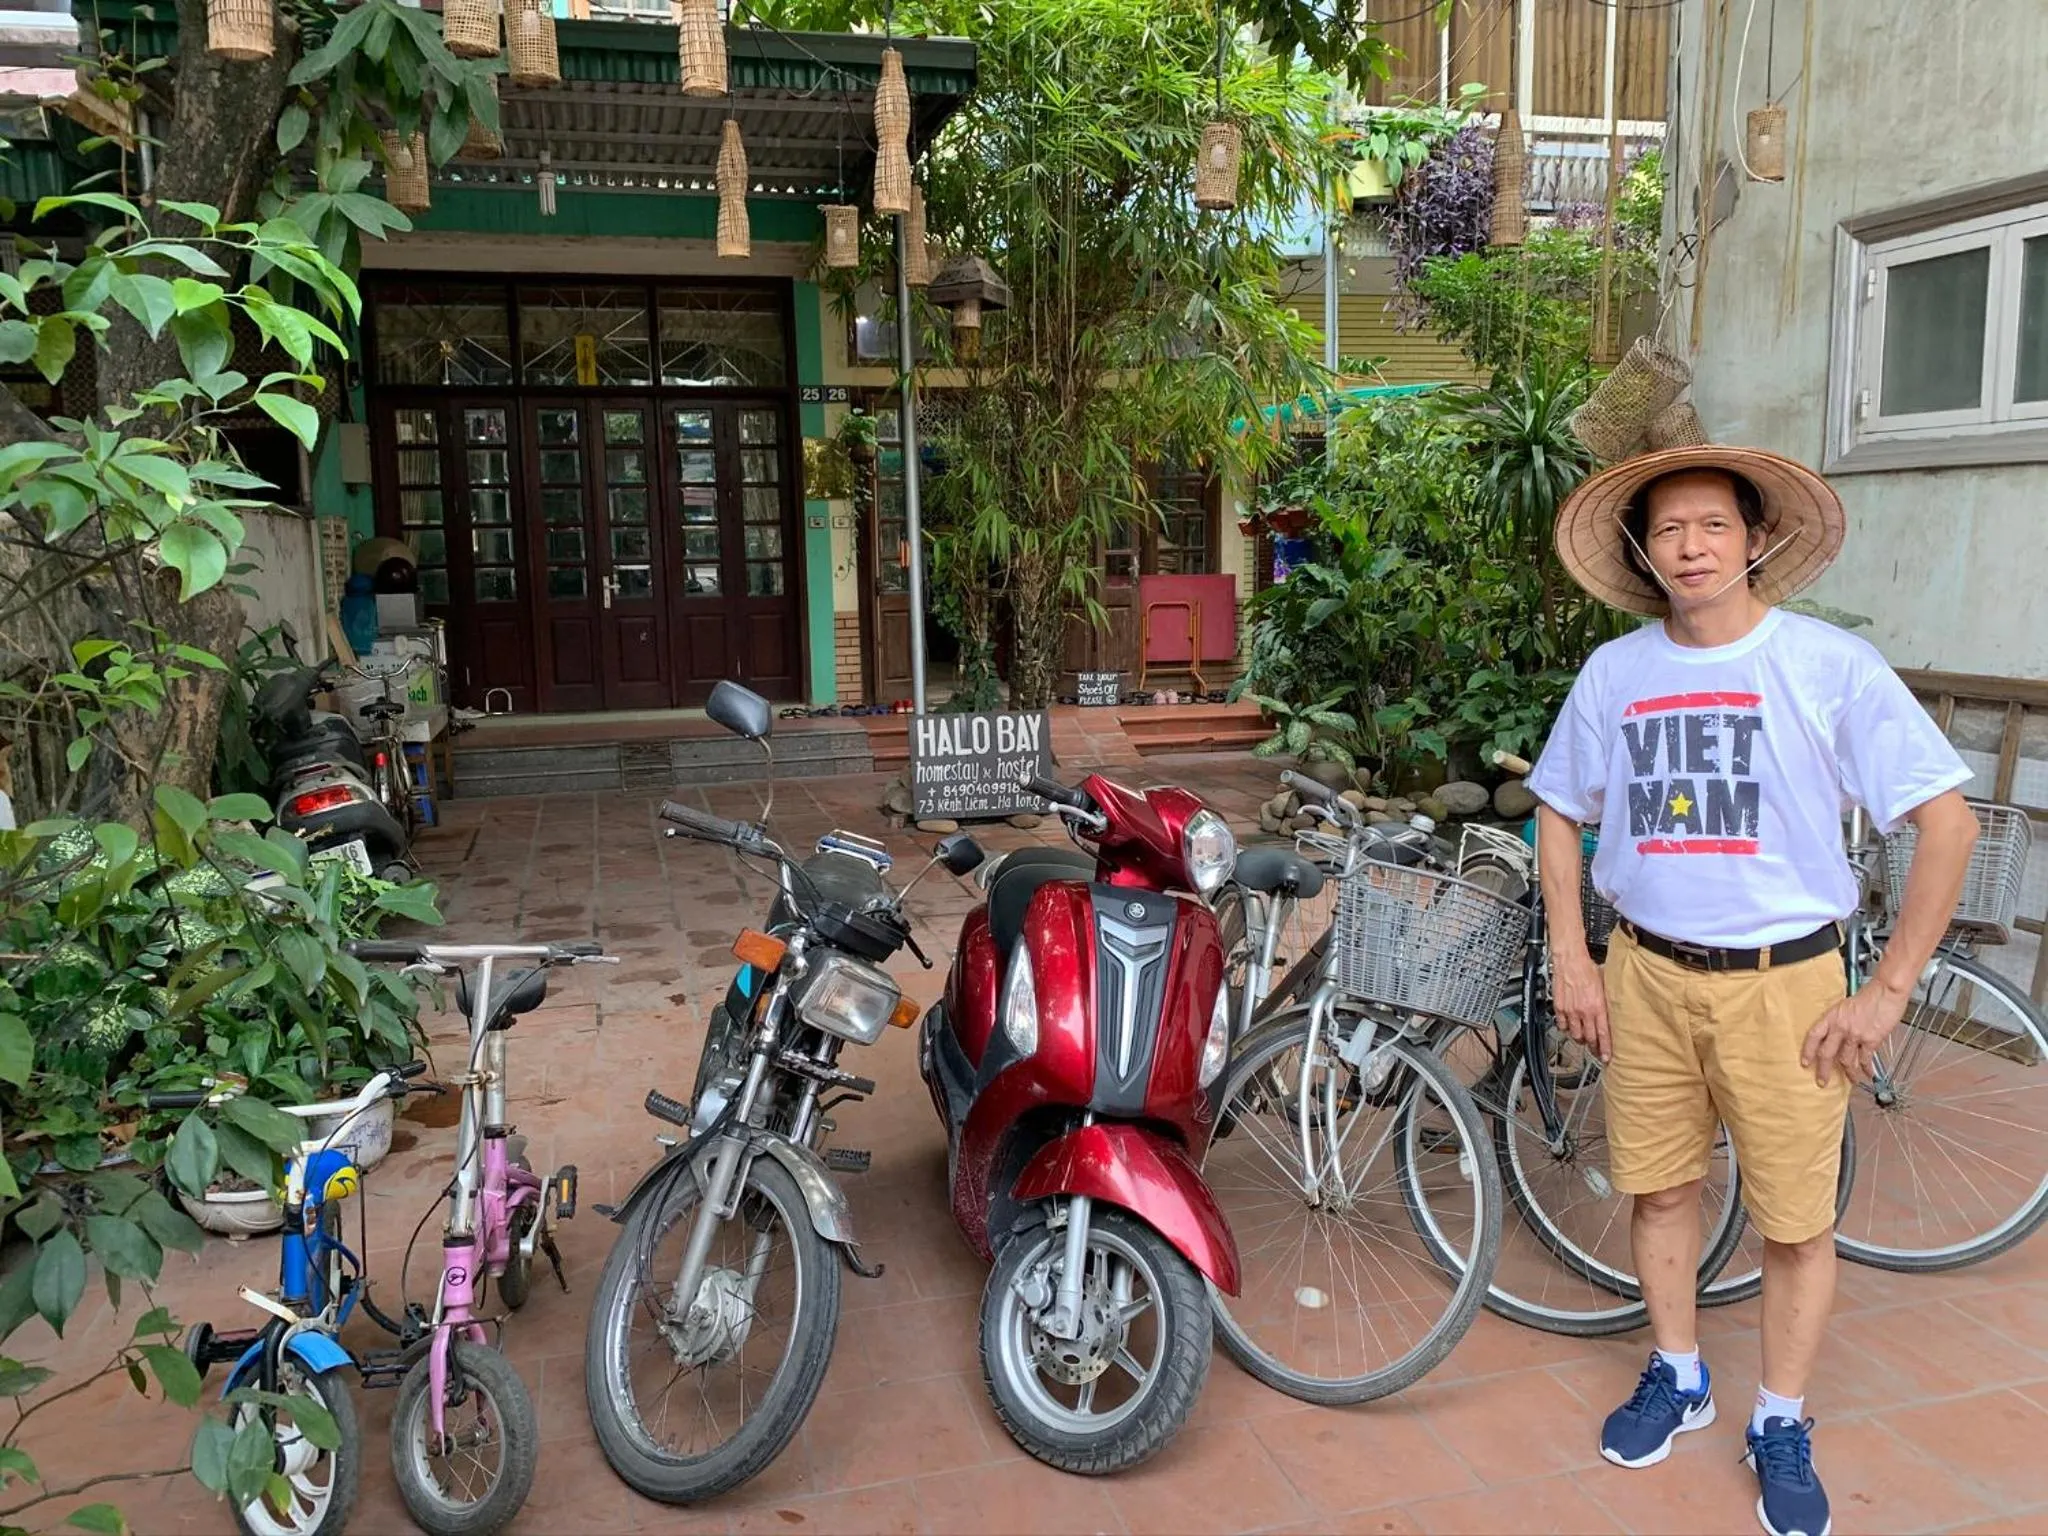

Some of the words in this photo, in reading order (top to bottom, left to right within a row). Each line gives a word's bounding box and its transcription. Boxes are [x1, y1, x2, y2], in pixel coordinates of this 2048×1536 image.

[802, 388, 820, 401] 25
[828, 388, 847, 401] 26
[917, 716, 991, 757] HALO
[996, 713, 1042, 754] BAY
[1621, 713, 1763, 777] VIET
[916, 760, 980, 784] homestay
[997, 755, 1041, 780] hostel
[919, 799, 935, 813] 73
[1628, 779, 1760, 838] NAM
